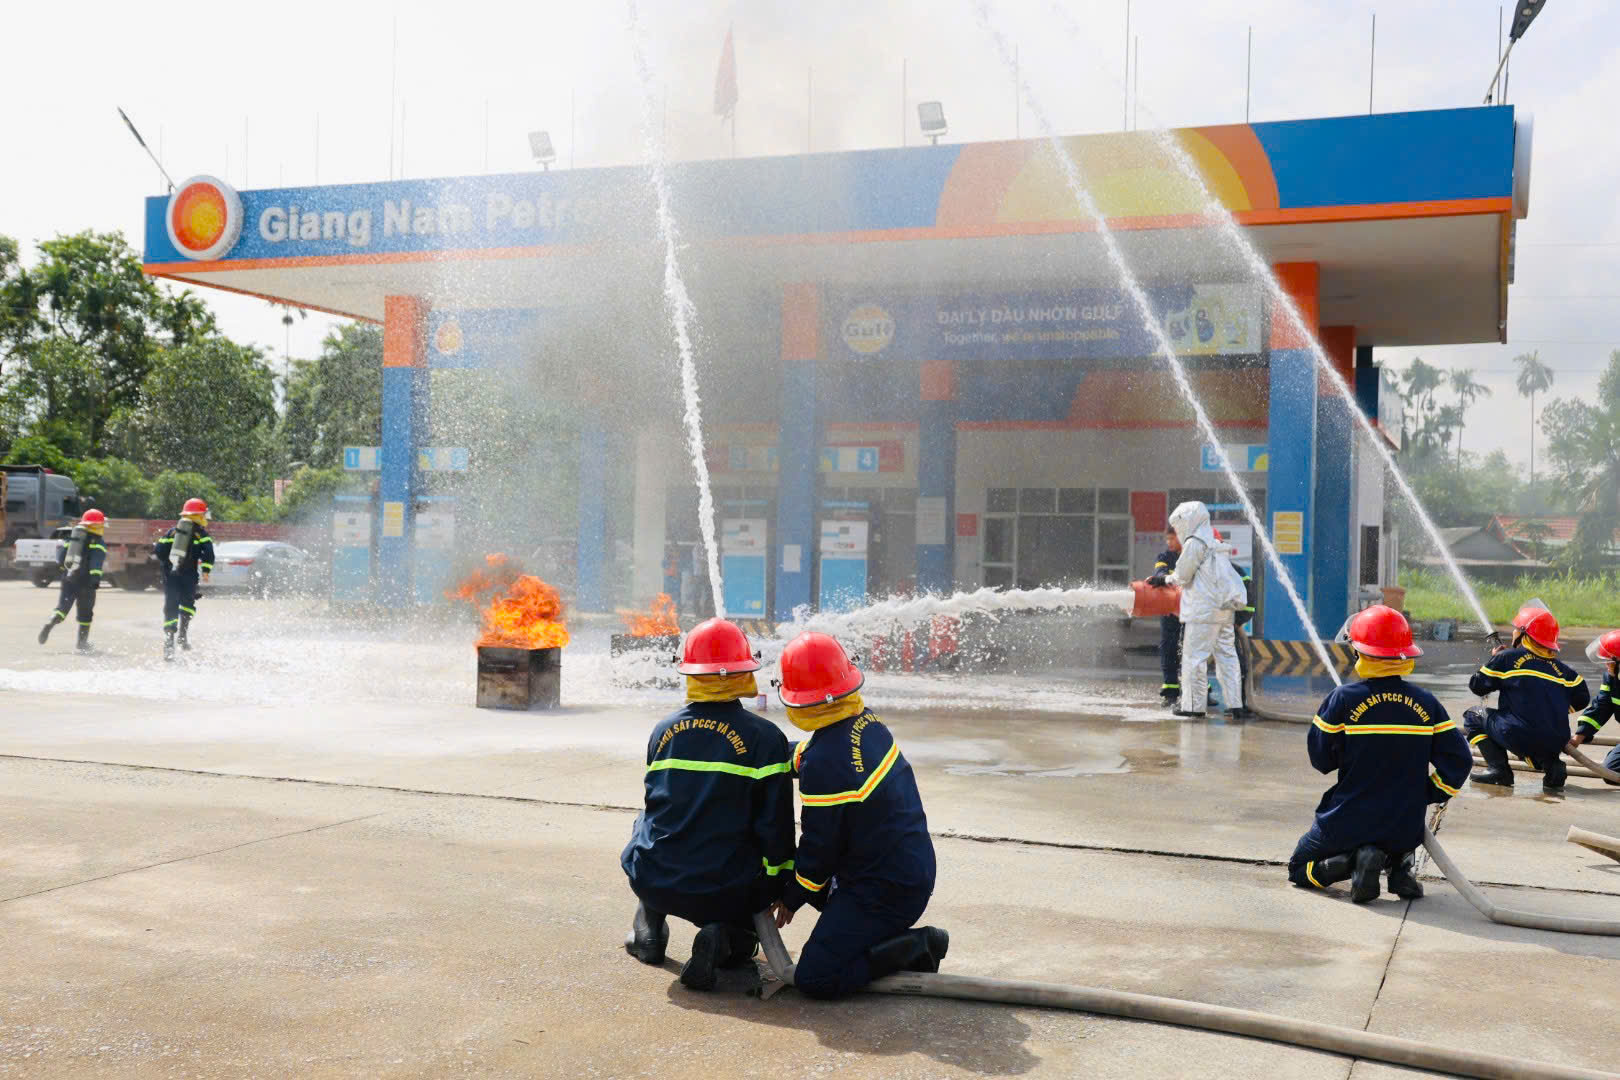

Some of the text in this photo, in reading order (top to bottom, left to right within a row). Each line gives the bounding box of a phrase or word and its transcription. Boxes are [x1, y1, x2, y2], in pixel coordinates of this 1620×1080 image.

[259, 204, 372, 247] Giang
[384, 199, 473, 237] Nam
[1382, 692, 1403, 702] PCCC
[1412, 702, 1431, 723] CNCH
[692, 718, 718, 731] PCCC
[726, 730, 748, 756] CNCH
